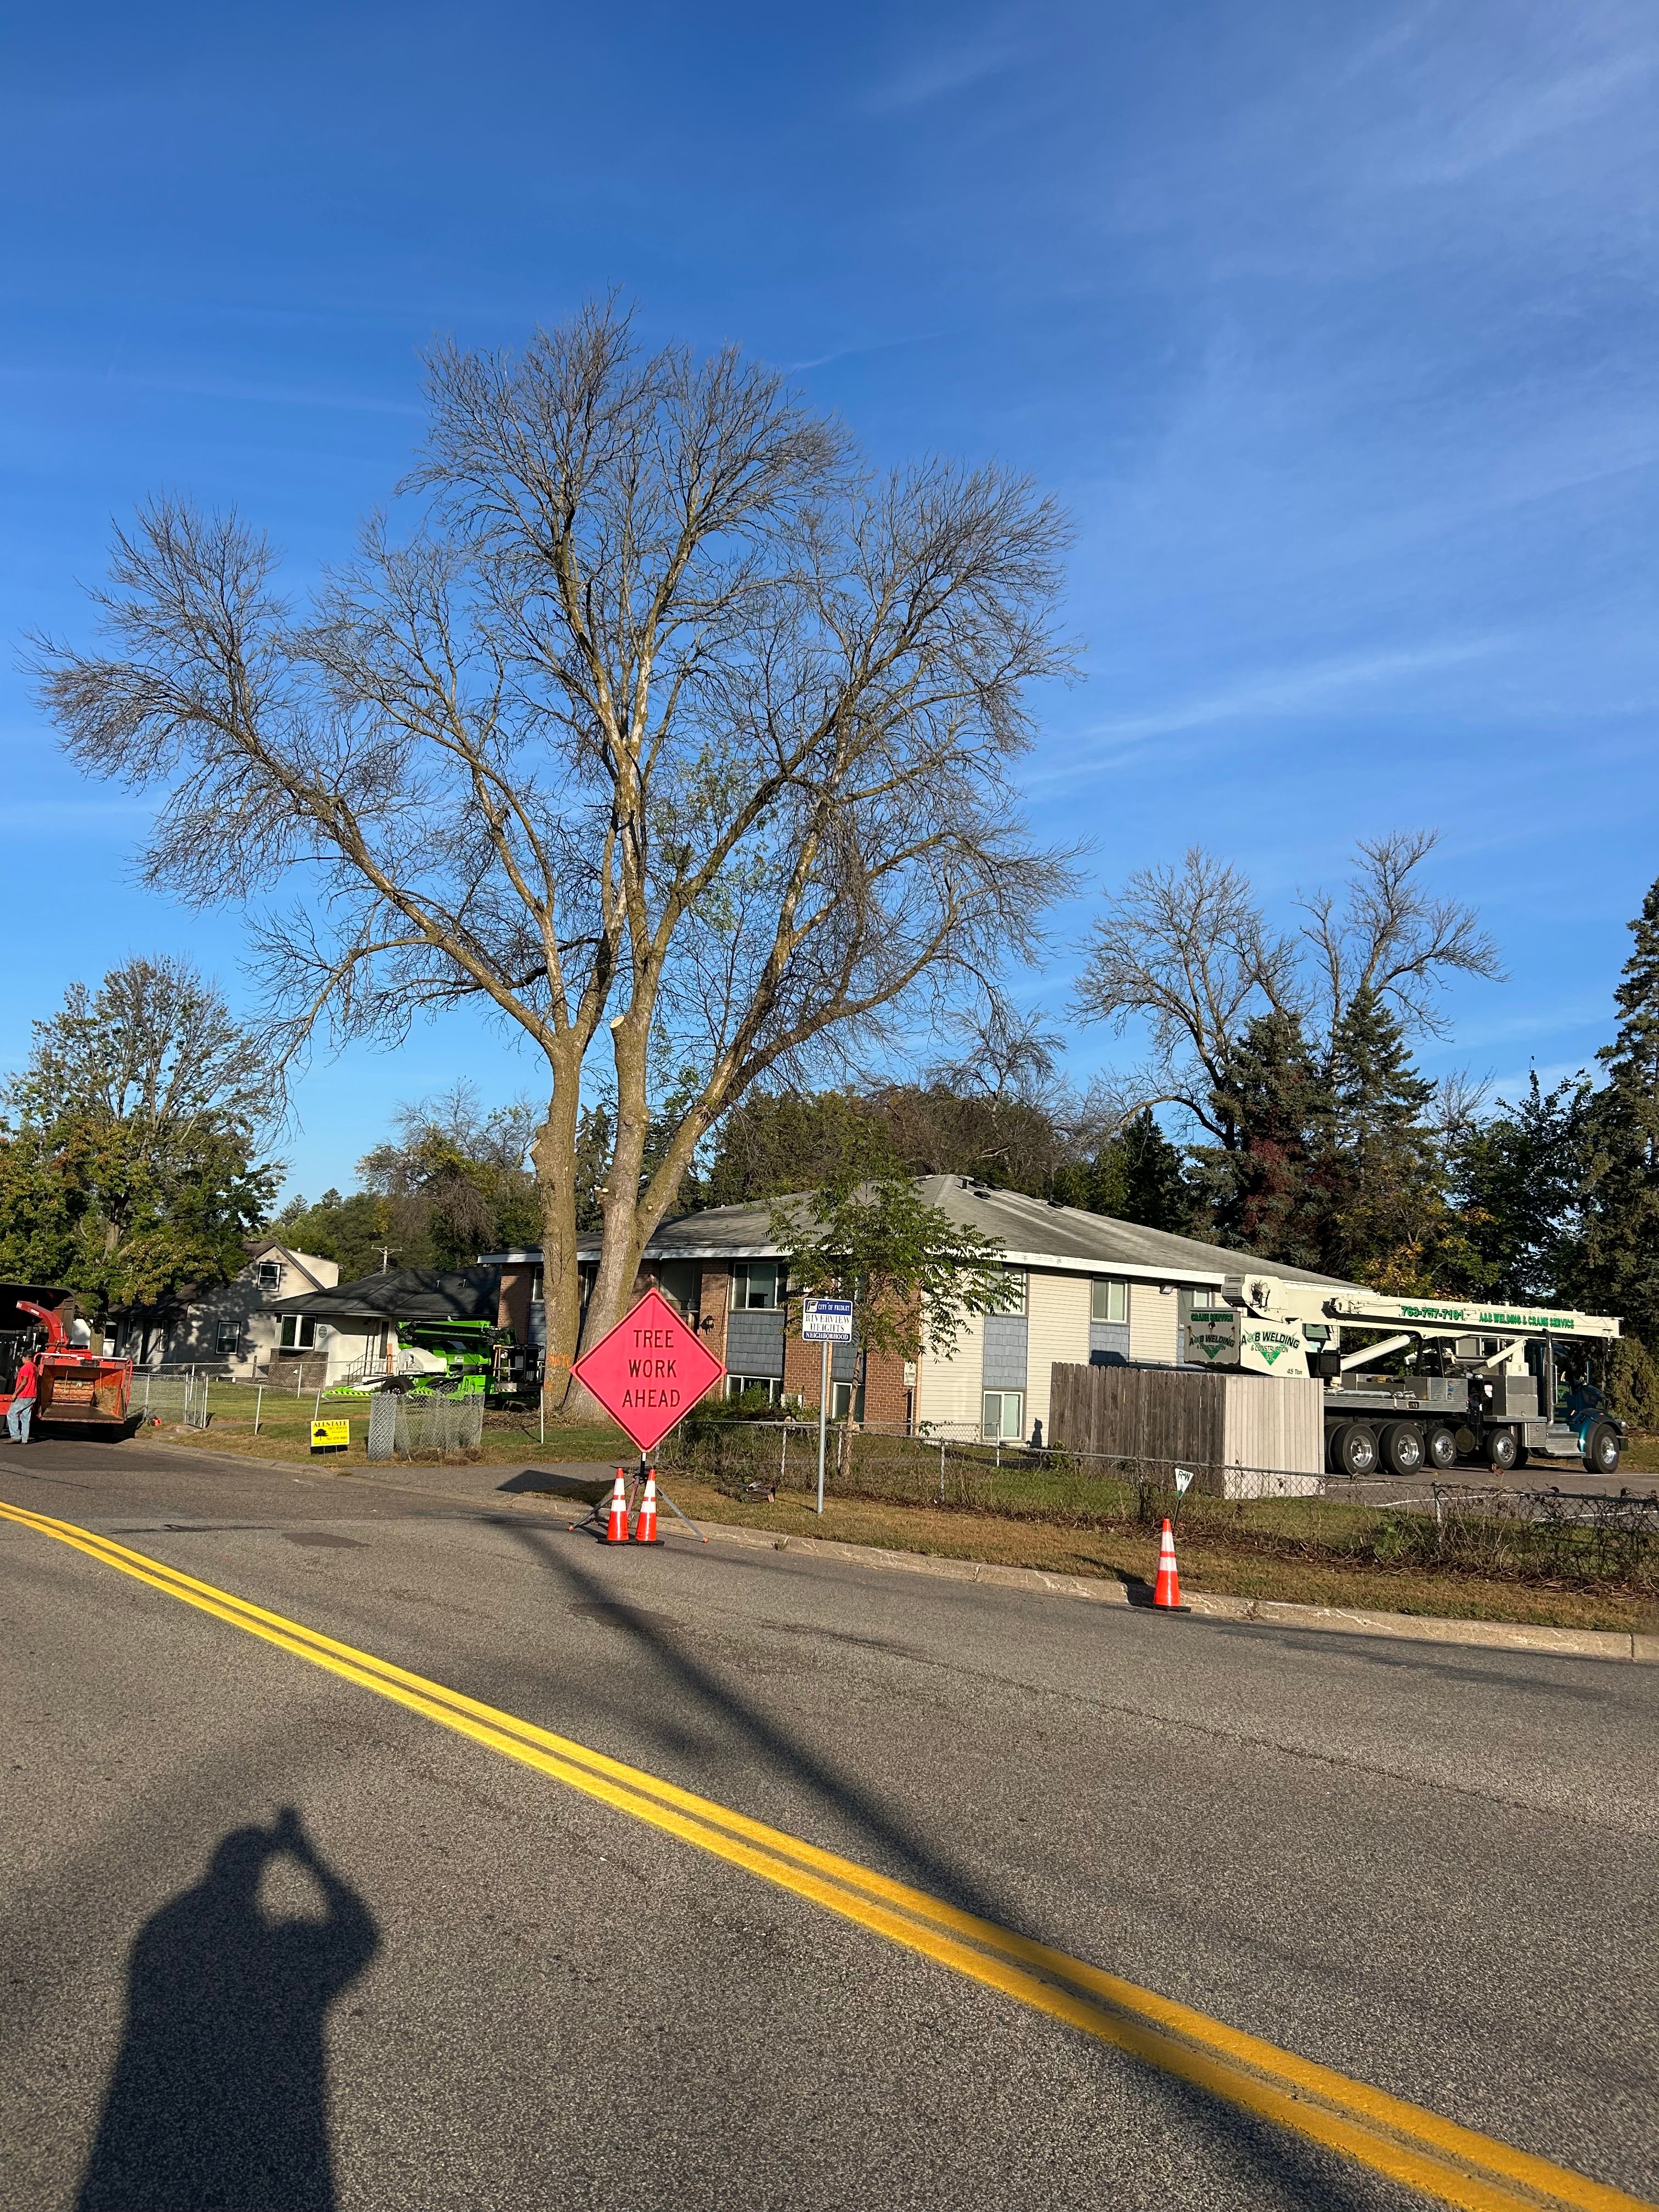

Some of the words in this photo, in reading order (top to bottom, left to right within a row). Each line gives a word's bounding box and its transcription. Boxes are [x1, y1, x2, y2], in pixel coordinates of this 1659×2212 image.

[805, 1314, 850, 1324] RIVERVIEW
[1190, 1313, 1209, 1322] CRANE
[1210, 1313, 1234, 1322] SERVICE
[1493, 1313, 1522, 1325] WELDING
[1522, 1315, 1527, 1325] &
[1528, 1316, 1549, 1327] CRANE
[1549, 1317, 1575, 1329] SERVICE
[810, 1323, 844, 1332] HEIGHTS
[633, 1330, 674, 1348] TREE
[805, 1331, 849, 1340] NEIGHBORHOOD
[1189, 1336, 1194, 1346] A
[1199, 1334, 1205, 1342] B
[1205, 1334, 1235, 1348] WELDING
[1241, 1334, 1248, 1346] A
[1254, 1330, 1261, 1343] B
[1262, 1330, 1300, 1350] WELDING
[1255, 1345, 1289, 1353] CONSTRUCTION
[628, 1359, 677, 1378] WORK
[622, 1389, 680, 1407] AHEAD
